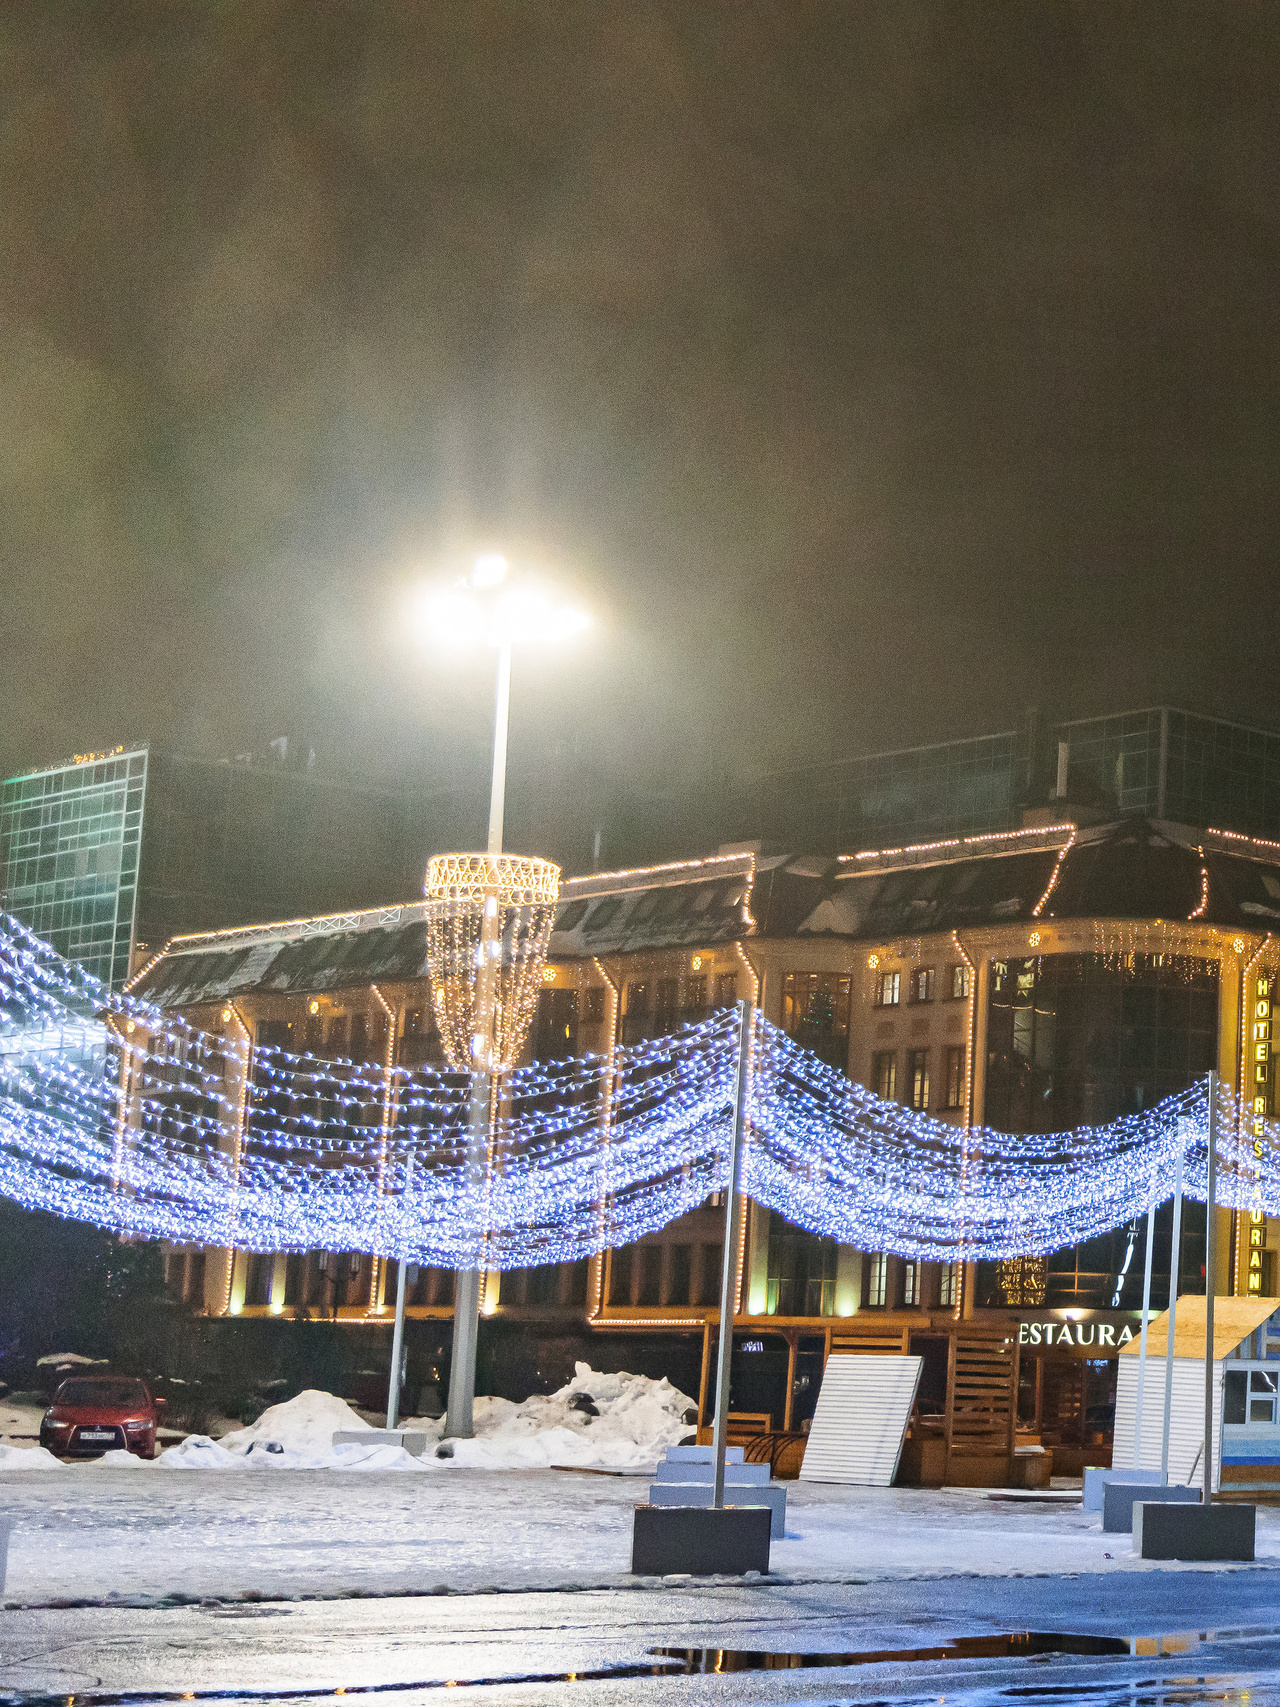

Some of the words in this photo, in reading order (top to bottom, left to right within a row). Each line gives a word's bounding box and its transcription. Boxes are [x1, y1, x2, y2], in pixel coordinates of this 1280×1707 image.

[1255, 979, 1268, 1082] HOTEL
[1249, 1097, 1264, 1298] RESURAN
[1003, 1322, 1142, 1346] ESTAURA
